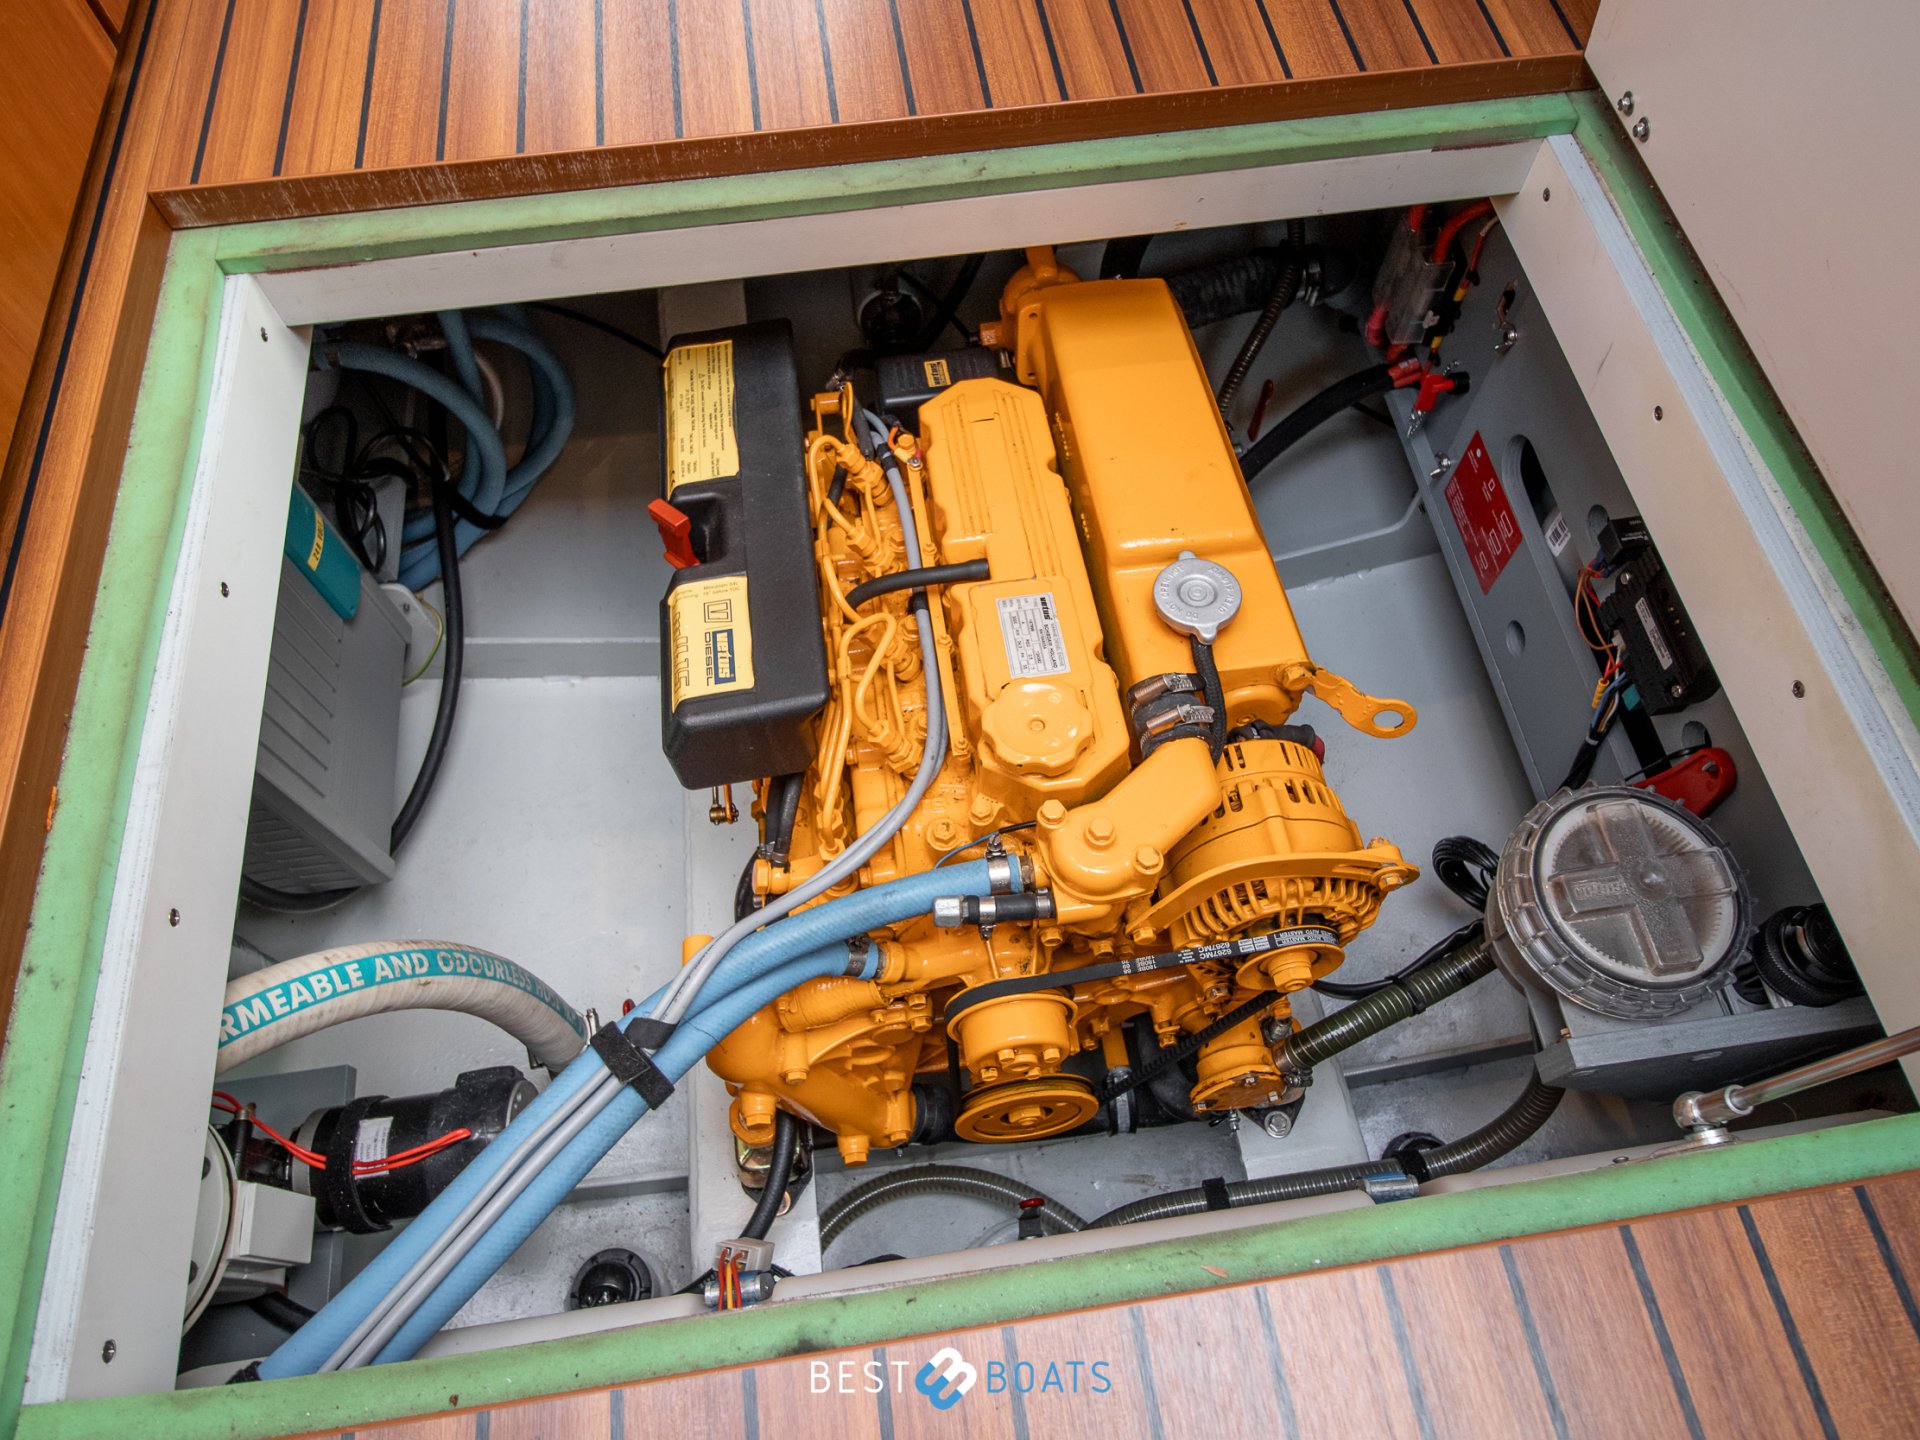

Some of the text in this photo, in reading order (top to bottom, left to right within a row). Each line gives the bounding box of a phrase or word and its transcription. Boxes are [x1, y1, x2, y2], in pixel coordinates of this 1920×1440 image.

[1040, 596, 1051, 620] vetus
[704, 631, 713, 686] DIESEL
[1050, 648, 1058, 669] HOLLAND
[1198, 942, 1230, 953] 6267MC
[1200, 948, 1232, 959] 6267MC
[374, 952, 430, 982] AND
[437, 950, 533, 992] ODOURLESS
